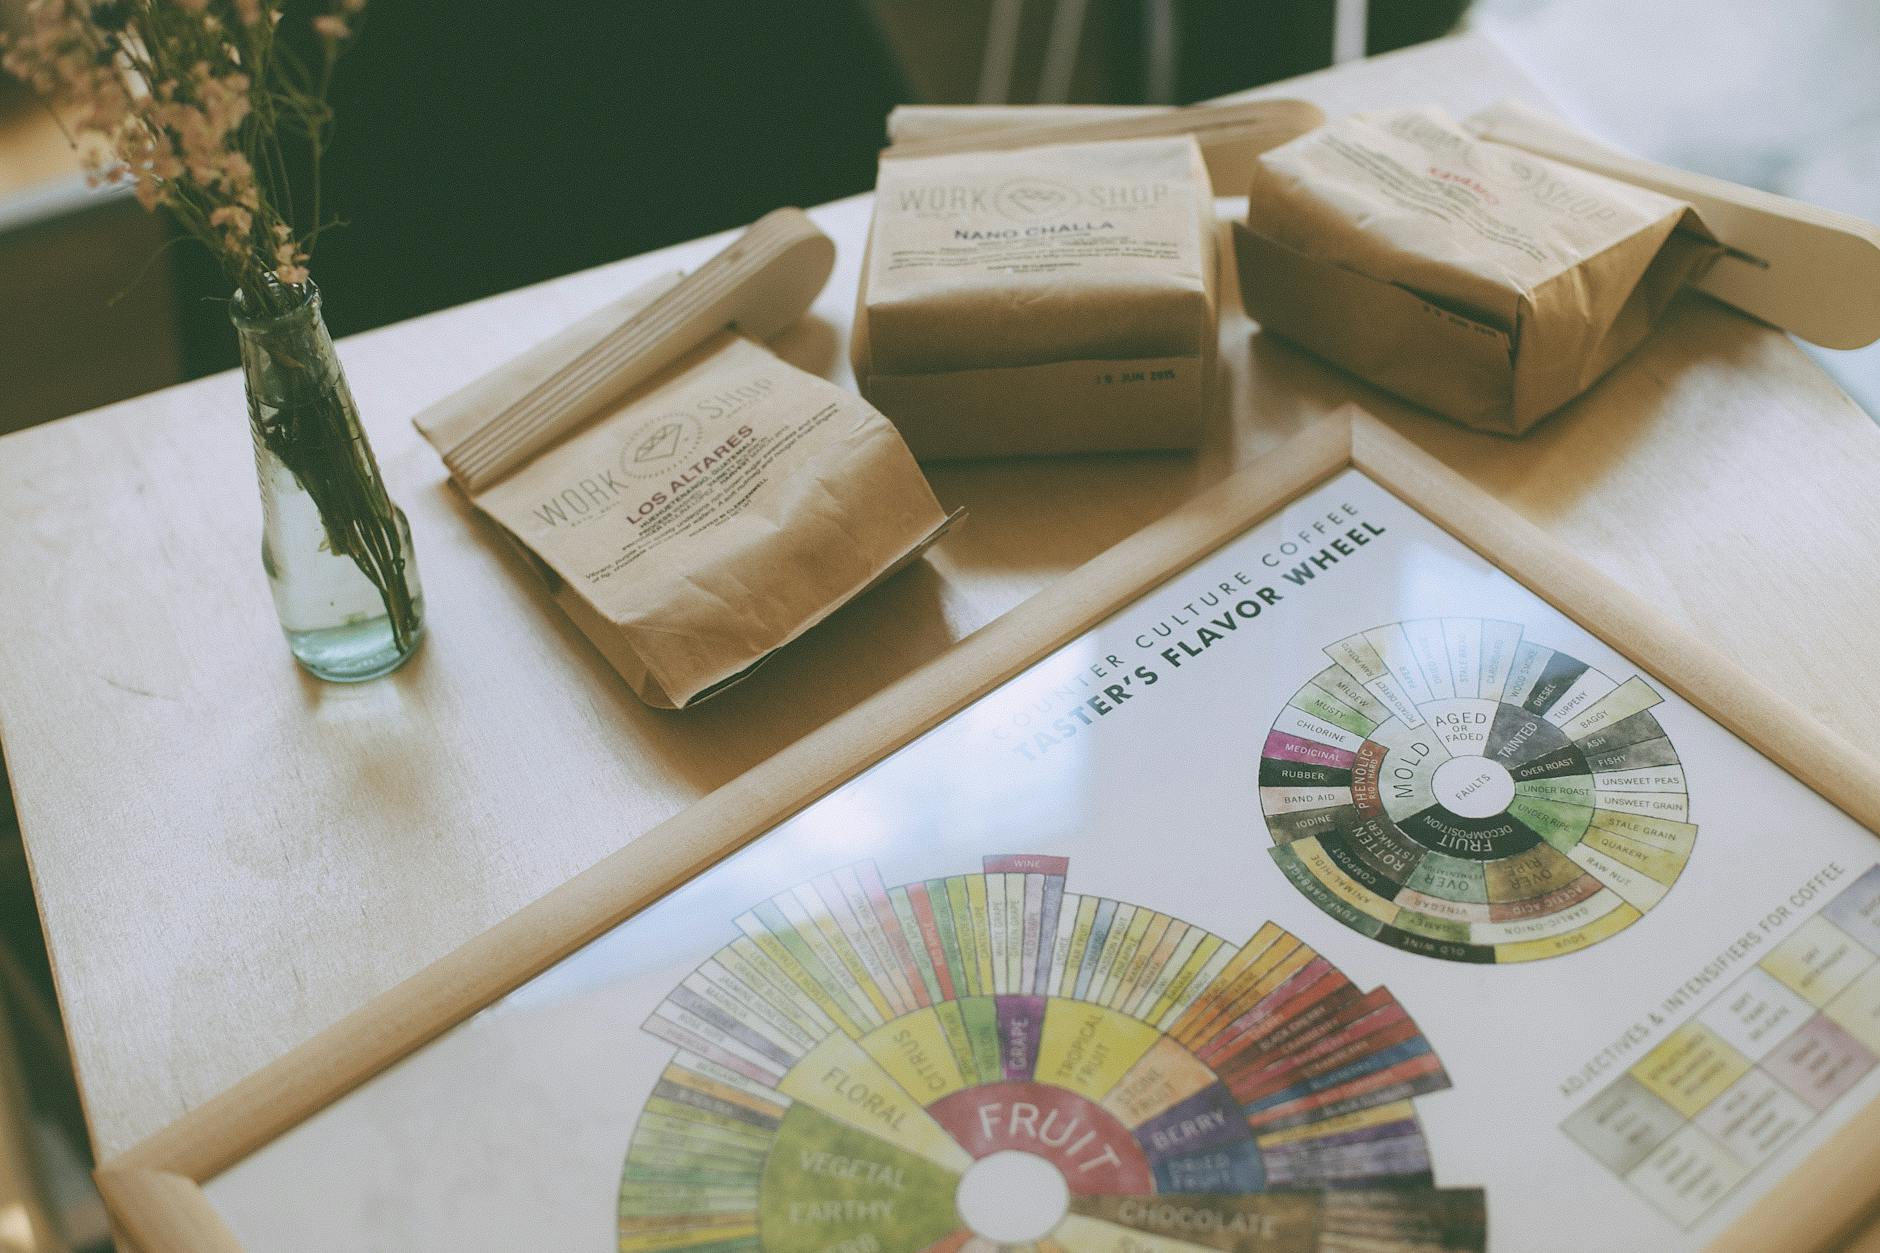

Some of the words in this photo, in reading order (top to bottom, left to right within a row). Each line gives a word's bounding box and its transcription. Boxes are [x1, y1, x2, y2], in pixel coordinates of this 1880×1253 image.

[954, 229, 1018, 239] NANO
[1025, 221, 1114, 237] CHALLA
[626, 492, 668, 525] LOS
[670, 425, 753, 493] ALTARES
[533, 469, 629, 528] WORK
[1136, 571, 1251, 649] CULTURE
[1262, 503, 1359, 568] COFFEE
[1161, 585, 1284, 668] FLAVOR
[1282, 519, 1386, 588] WHEEL
[1335, 681, 1370, 708] MILDEW
[1533, 684, 1556, 707] DIESEL
[1553, 690, 1588, 719] TURPENY
[1314, 698, 1346, 719] MUSTY
[1435, 712, 1487, 727] AGED
[1580, 710, 1609, 729] BAGGY
[1297, 719, 1346, 742] CHLORINE
[1445, 733, 1484, 743] FADED
[1497, 721, 1538, 759] TAINTED
[1285, 744, 1341, 762] MEDICINAL
[1587, 737, 1606, 750] ASH
[1394, 741, 1431, 799] MOLD
[1520, 766, 1545, 778] OVER
[1546, 757, 1575, 771] ROAST
[1599, 755, 1626, 767] FISHY
[1282, 770, 1325, 781] RUBBER
[1354, 748, 1374, 809] PHENOLIC
[1602, 777, 1650, 786] UNSWEET
[1654, 776, 1680, 785] PEAS
[1284, 794, 1314, 804] BAND
[1317, 793, 1335, 801] AID
[1455, 773, 1491, 802] FAULTS
[1523, 785, 1556, 795] UNDER
[1559, 787, 1590, 796] ROAST
[1517, 804, 1548, 824] UNDER
[1604, 797, 1650, 809] UNSWEET
[1653, 801, 1683, 812] GRAIN
[1296, 814, 1331, 829] IODINE
[1423, 815, 1513, 840] DECOMPOSITION
[1608, 818, 1639, 832] STALE
[1643, 826, 1676, 841] GRAIN
[1353, 826, 1405, 872] ROTTEN
[1366, 820, 1415, 862] (STINKER)
[1437, 834, 1492, 852] FRUIT
[1601, 839, 1649, 862] QUAKERY
[1013, 858, 1041, 869] WINE
[1311, 855, 1334, 875] HIDE
[1332, 848, 1377, 885] COMPOST
[1504, 857, 1543, 873] RIPE
[1587, 857, 1608, 873] RAW
[1608, 871, 1633, 886] NUT
[1335, 876, 1370, 904] ANIMAL
[1425, 874, 1469, 892] OVER
[1511, 869, 1553, 890] OVER
[1414, 900, 1467, 915] VINEGAR
[1512, 902, 1540, 914] ACID
[1558, 1023, 1650, 1098] ADJECTIVES
[1649, 1012, 1664, 1027] &
[1663, 931, 1763, 1015] INTENSIFIERS
[1761, 906, 1794, 935] FOR
[1789, 861, 1846, 908] COFFEE
[1009, 1017, 1028, 1070] GRAPE
[1056, 1009, 1104, 1080] TROPICAL
[893, 1029, 947, 1091] CITRUS
[820, 1067, 908, 1131] FLORAL
[977, 1103, 1122, 1174] FRUIT
[1150, 1108, 1227, 1150] BERRY
[800, 1150, 906, 1191] VEGETAL
[1119, 1200, 1274, 1240] CHOCOLATE
